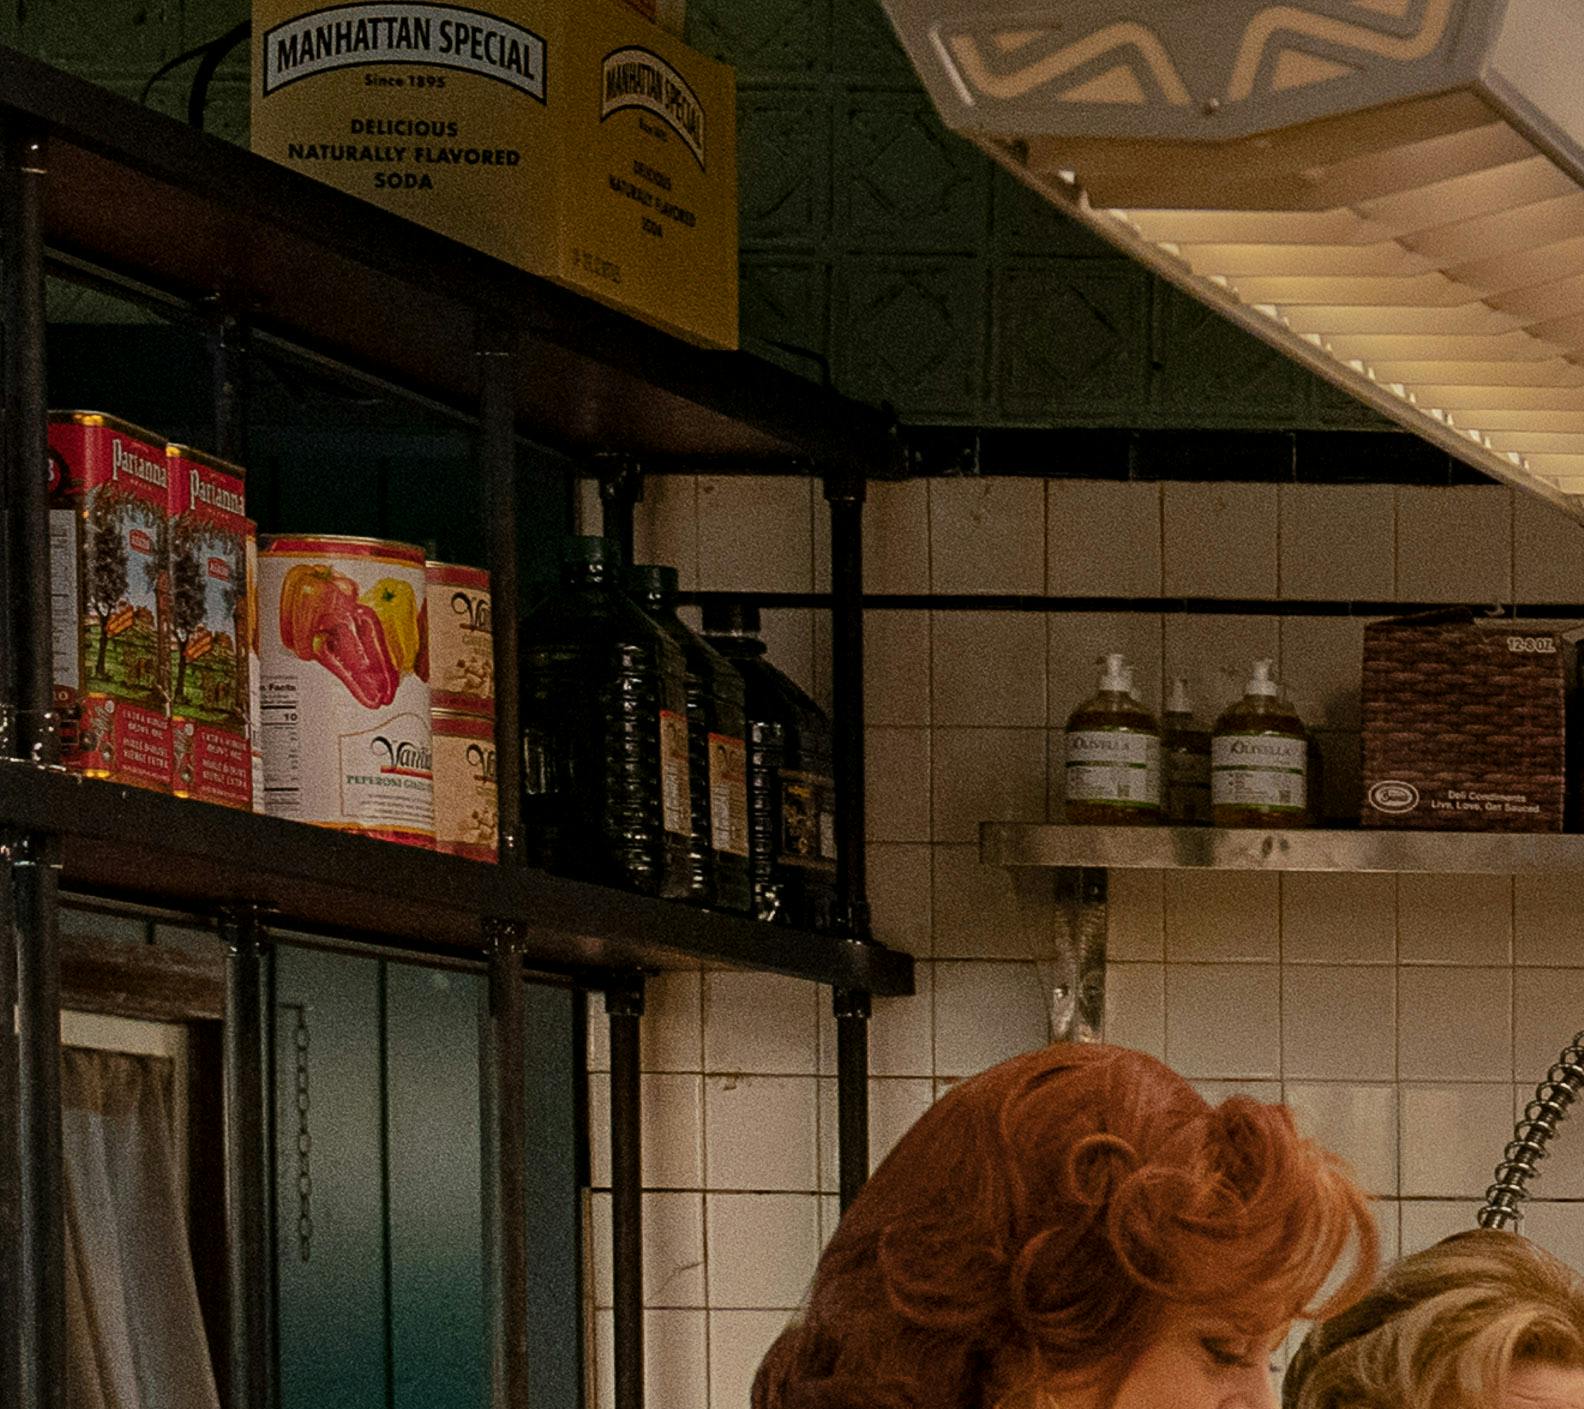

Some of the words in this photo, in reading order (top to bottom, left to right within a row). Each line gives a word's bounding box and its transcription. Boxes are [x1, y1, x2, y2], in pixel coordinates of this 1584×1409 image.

[277, 16, 431, 74] MANHATTAN
[438, 19, 535, 81] SPECIAL
[364, 73, 403, 88] Since
[410, 75, 446, 89] 1895
[606, 62, 662, 102] MANHATTAN
[665, 77, 701, 149] SPECIAL
[351, 118, 458, 137] DELICIOUS
[288, 143, 406, 163] NATURALLY
[415, 147, 521, 167] FLAVORED
[374, 172, 434, 190] SODA
